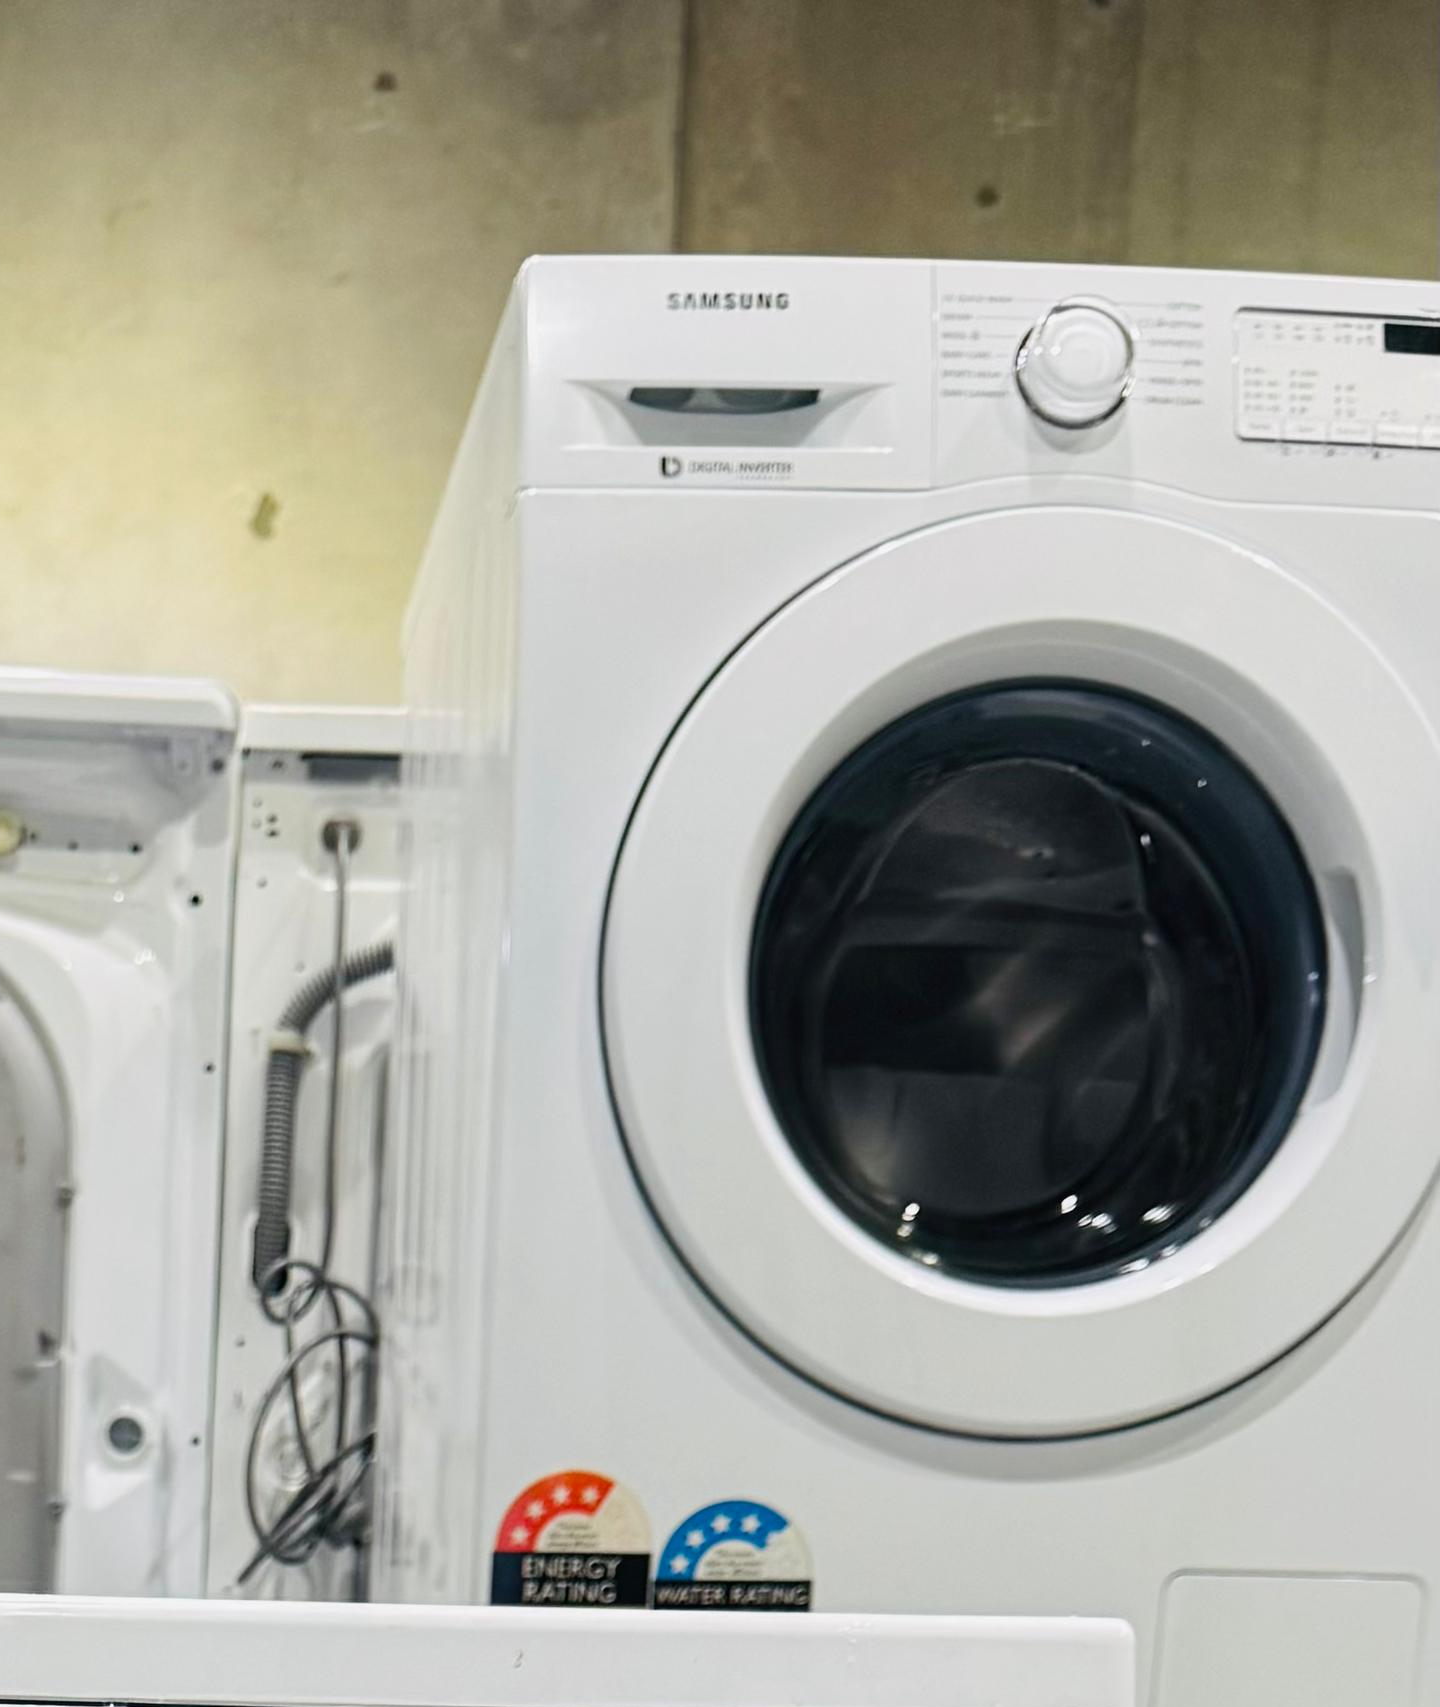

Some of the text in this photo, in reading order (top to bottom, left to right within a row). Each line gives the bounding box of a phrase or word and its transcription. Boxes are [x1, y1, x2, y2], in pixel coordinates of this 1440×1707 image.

[667, 292, 790, 310] SAMSUNG
[521, 1557, 622, 1579] ENERGY
[523, 1582, 617, 1604] RATING
[660, 1585, 809, 1606] WATER RATING
